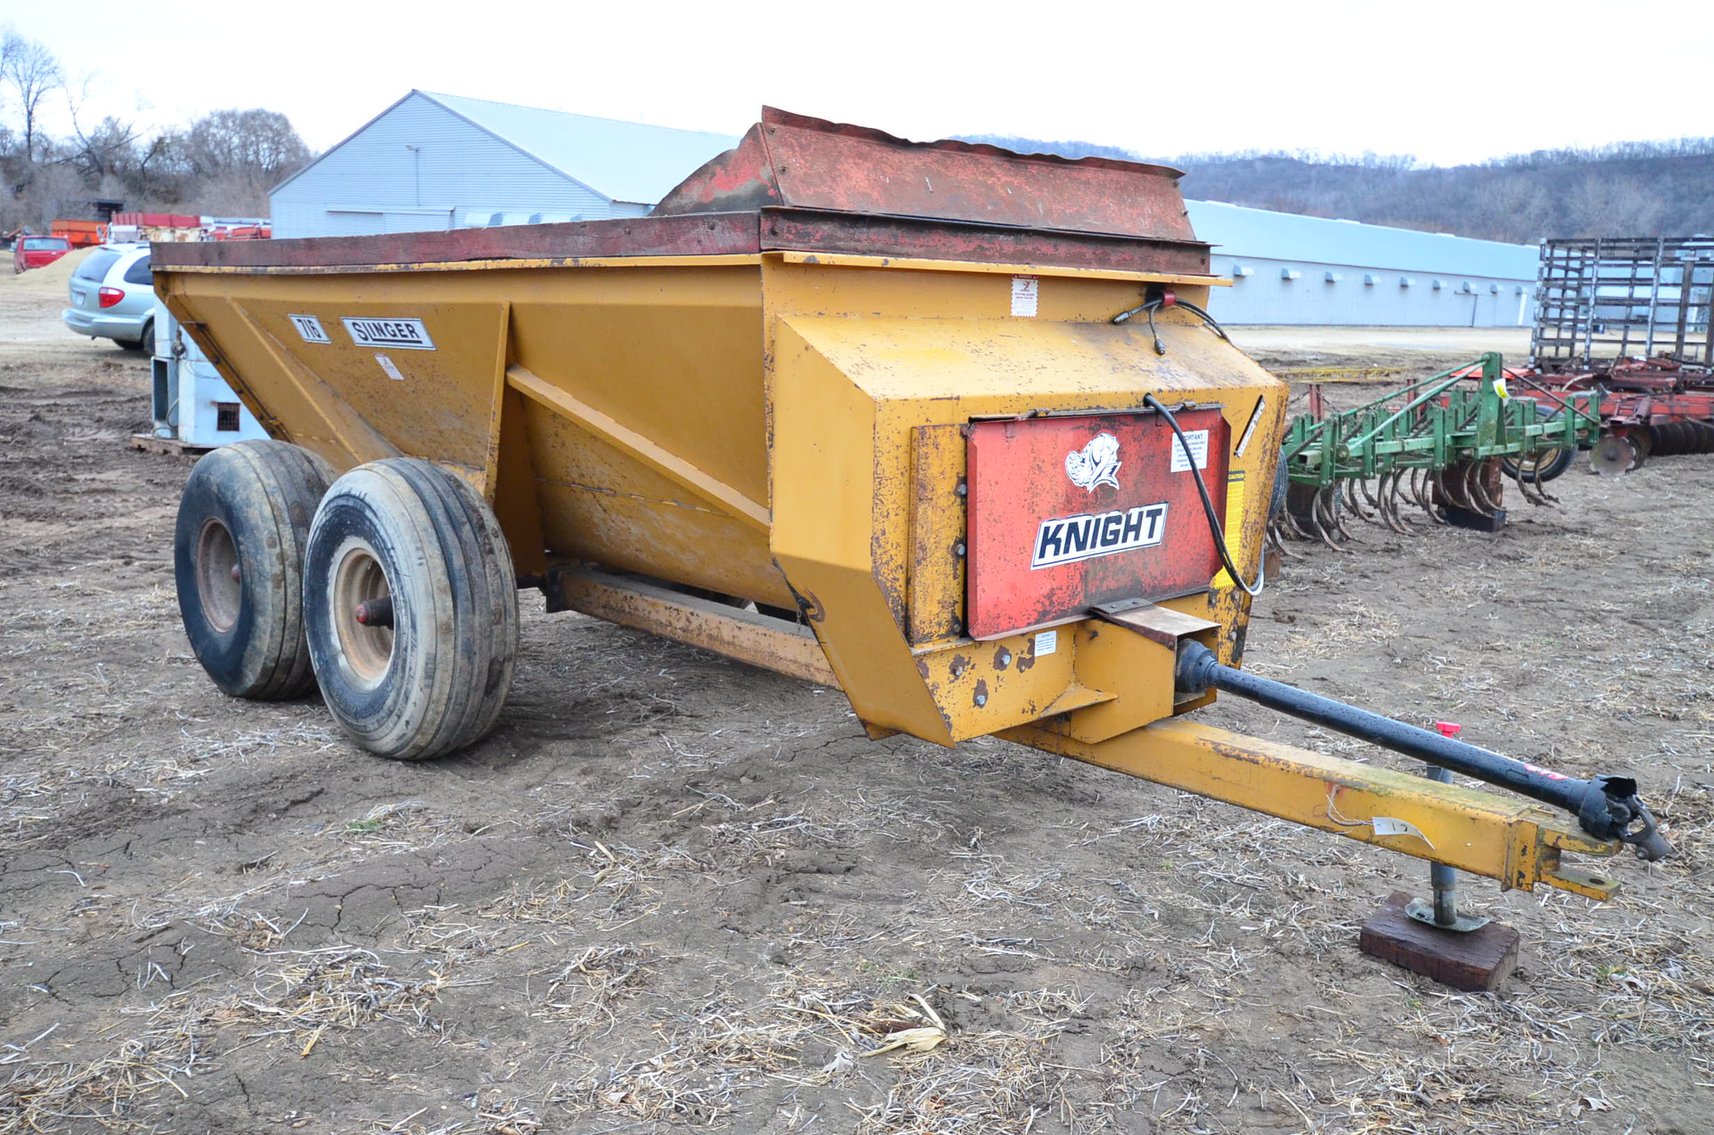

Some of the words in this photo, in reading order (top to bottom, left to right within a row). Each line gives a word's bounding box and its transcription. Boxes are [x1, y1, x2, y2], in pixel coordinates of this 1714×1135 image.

[296, 319, 322, 338] 716
[352, 322, 422, 343] SLINGER
[1038, 508, 1163, 559] KNIGHT
